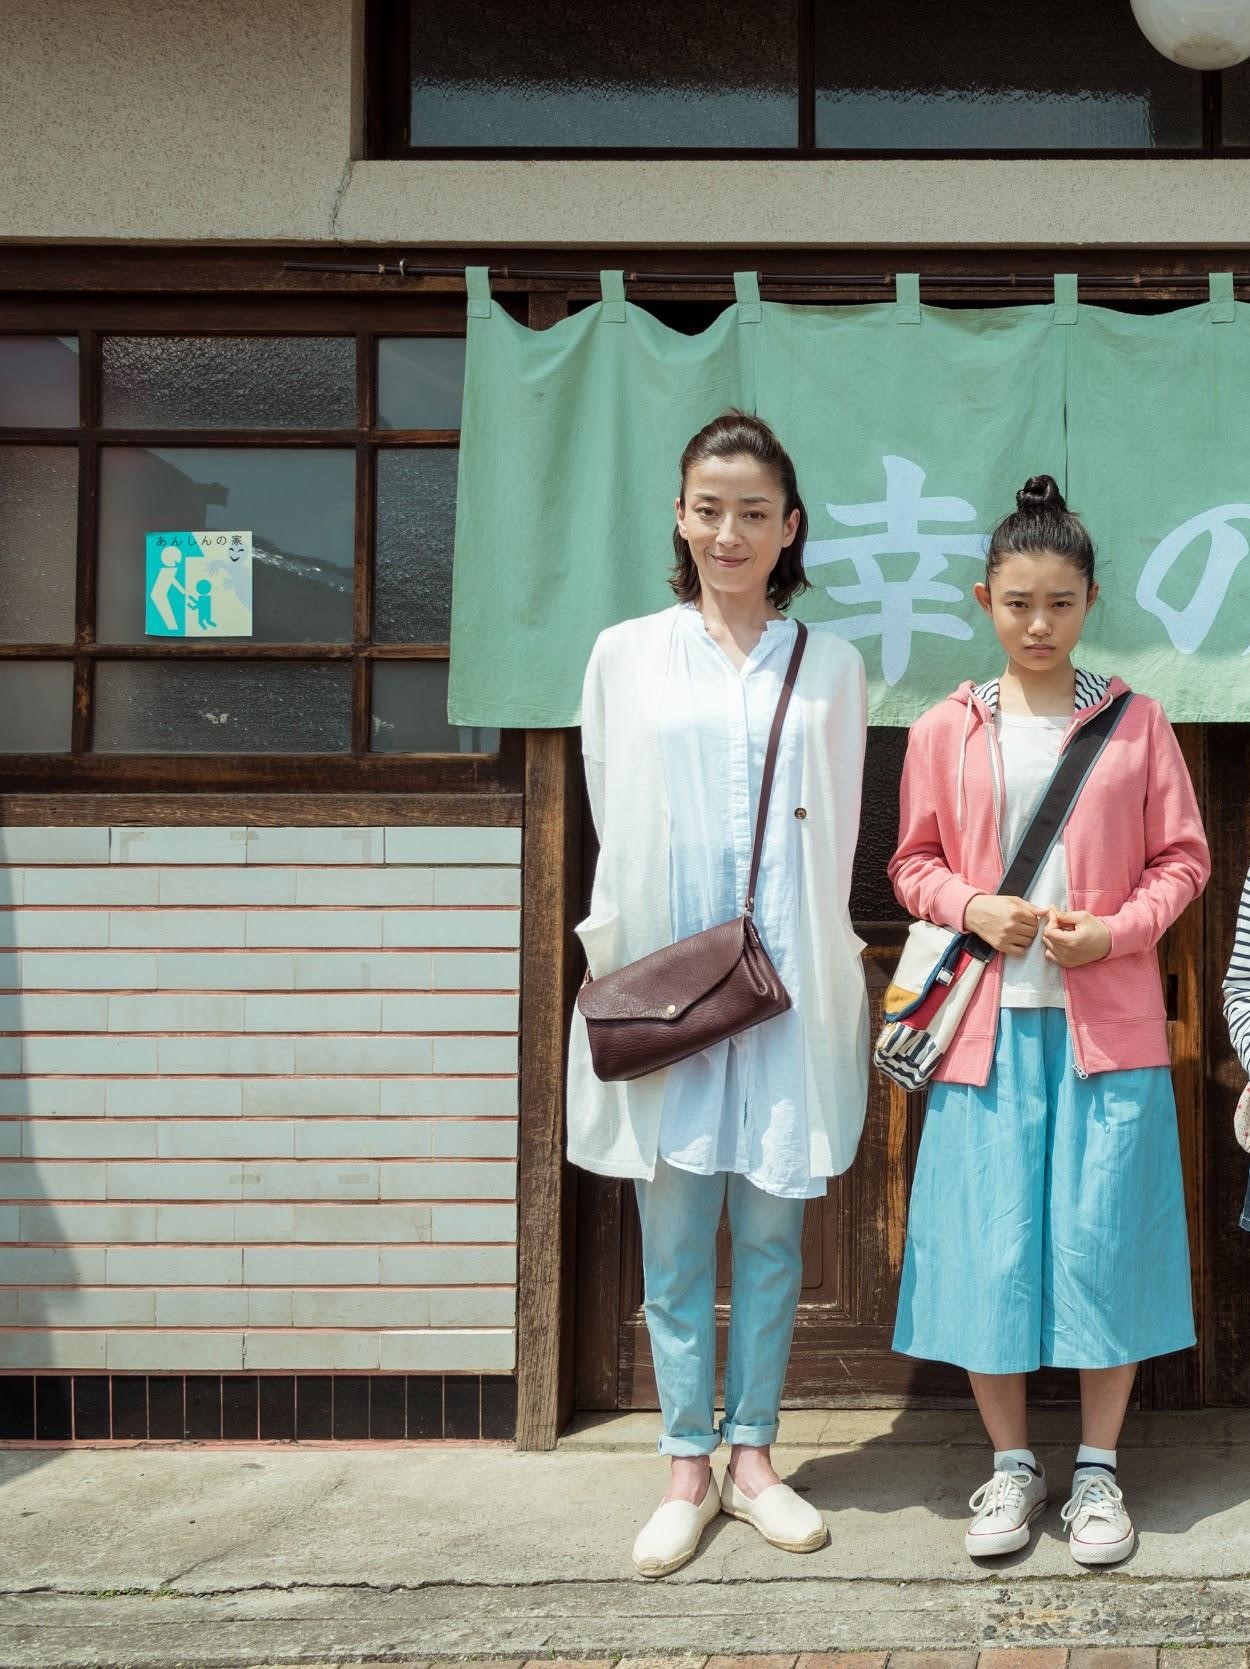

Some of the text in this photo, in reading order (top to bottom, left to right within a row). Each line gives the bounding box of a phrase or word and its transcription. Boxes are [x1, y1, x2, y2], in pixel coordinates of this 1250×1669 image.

[156, 535, 242, 547] あんしんの家
